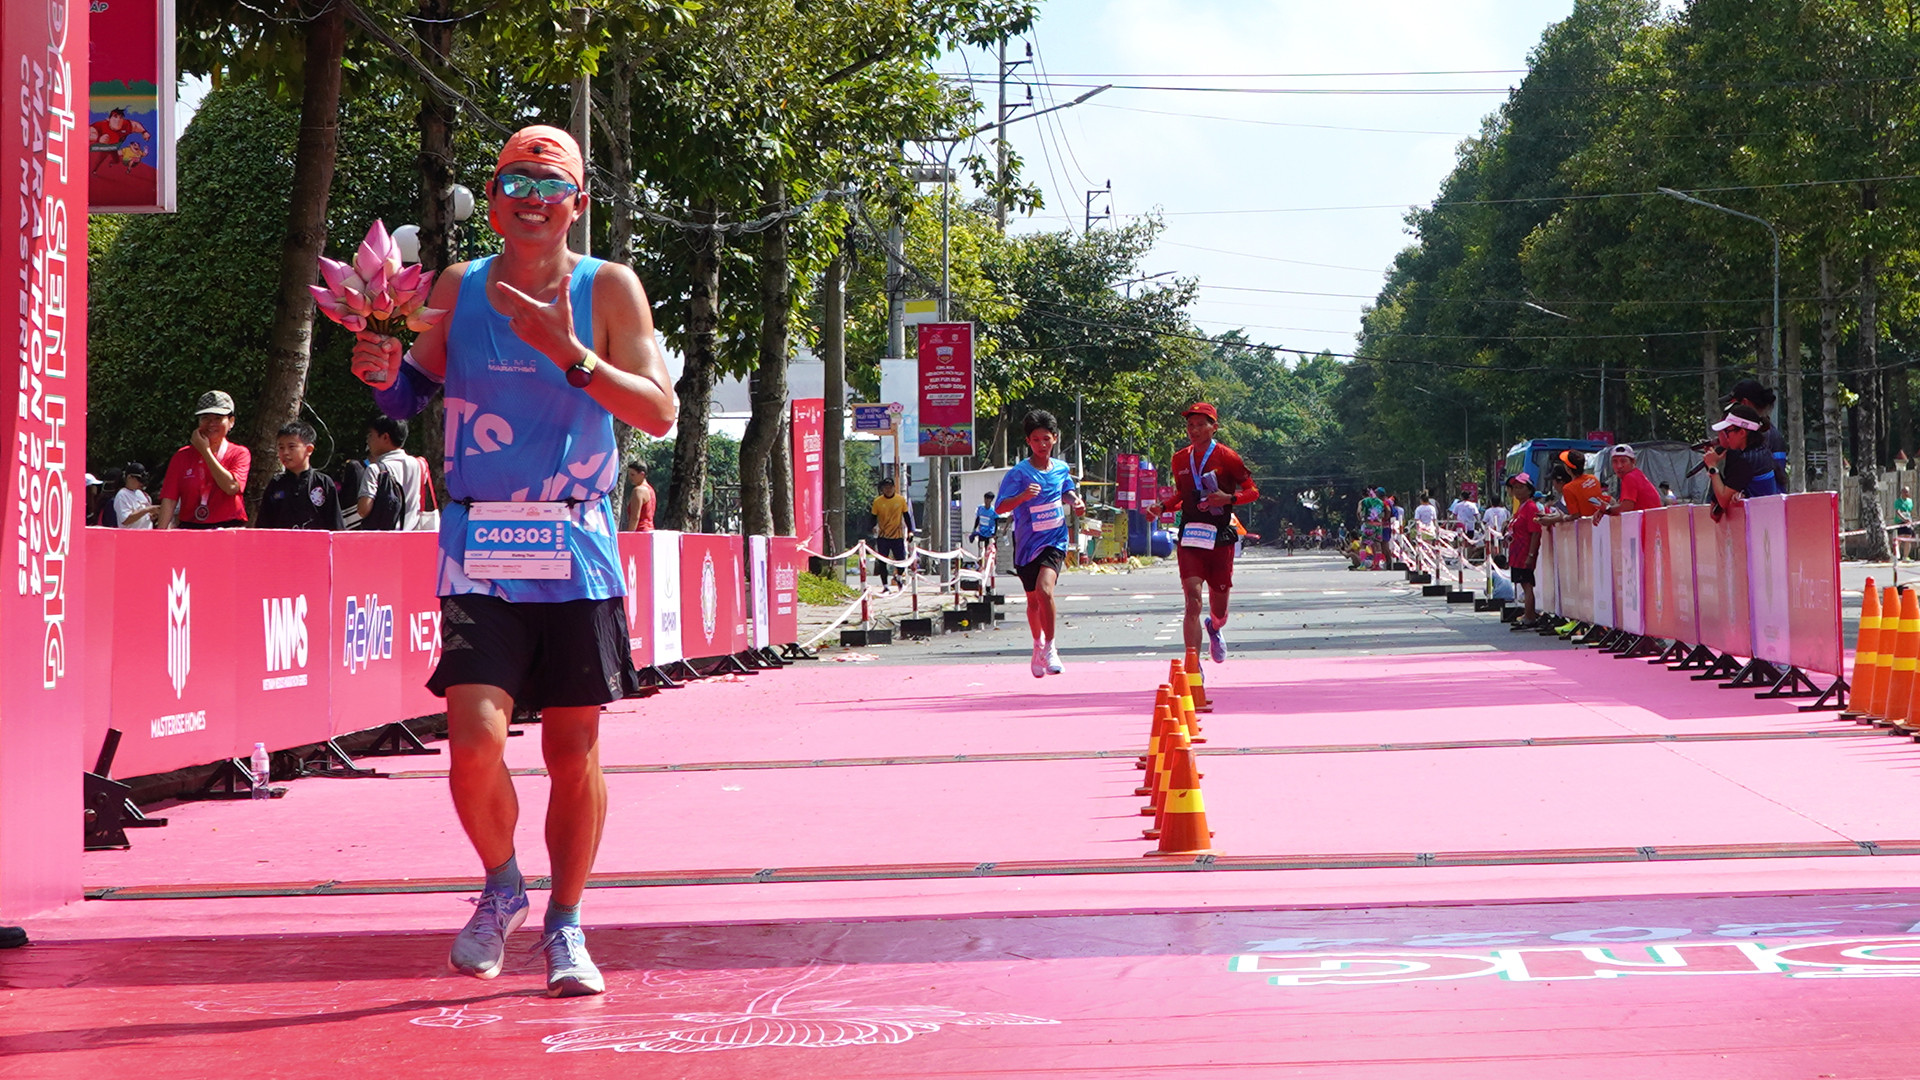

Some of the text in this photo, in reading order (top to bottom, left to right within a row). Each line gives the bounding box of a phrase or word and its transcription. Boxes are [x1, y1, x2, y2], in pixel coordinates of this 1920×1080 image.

[18, 54, 32, 595] CÚP MASTERISE HOMES
[30, 60, 45, 595] MARATHON 2024
[45, 195, 68, 378] SEN
[488, 364, 537, 373] MARATHON
[43, 394, 73, 689] HỒNG
[474, 527, 552, 543] C40303
[262, 593, 309, 672] VNMS
[151, 710, 206, 739] MASTERISE HOMES
